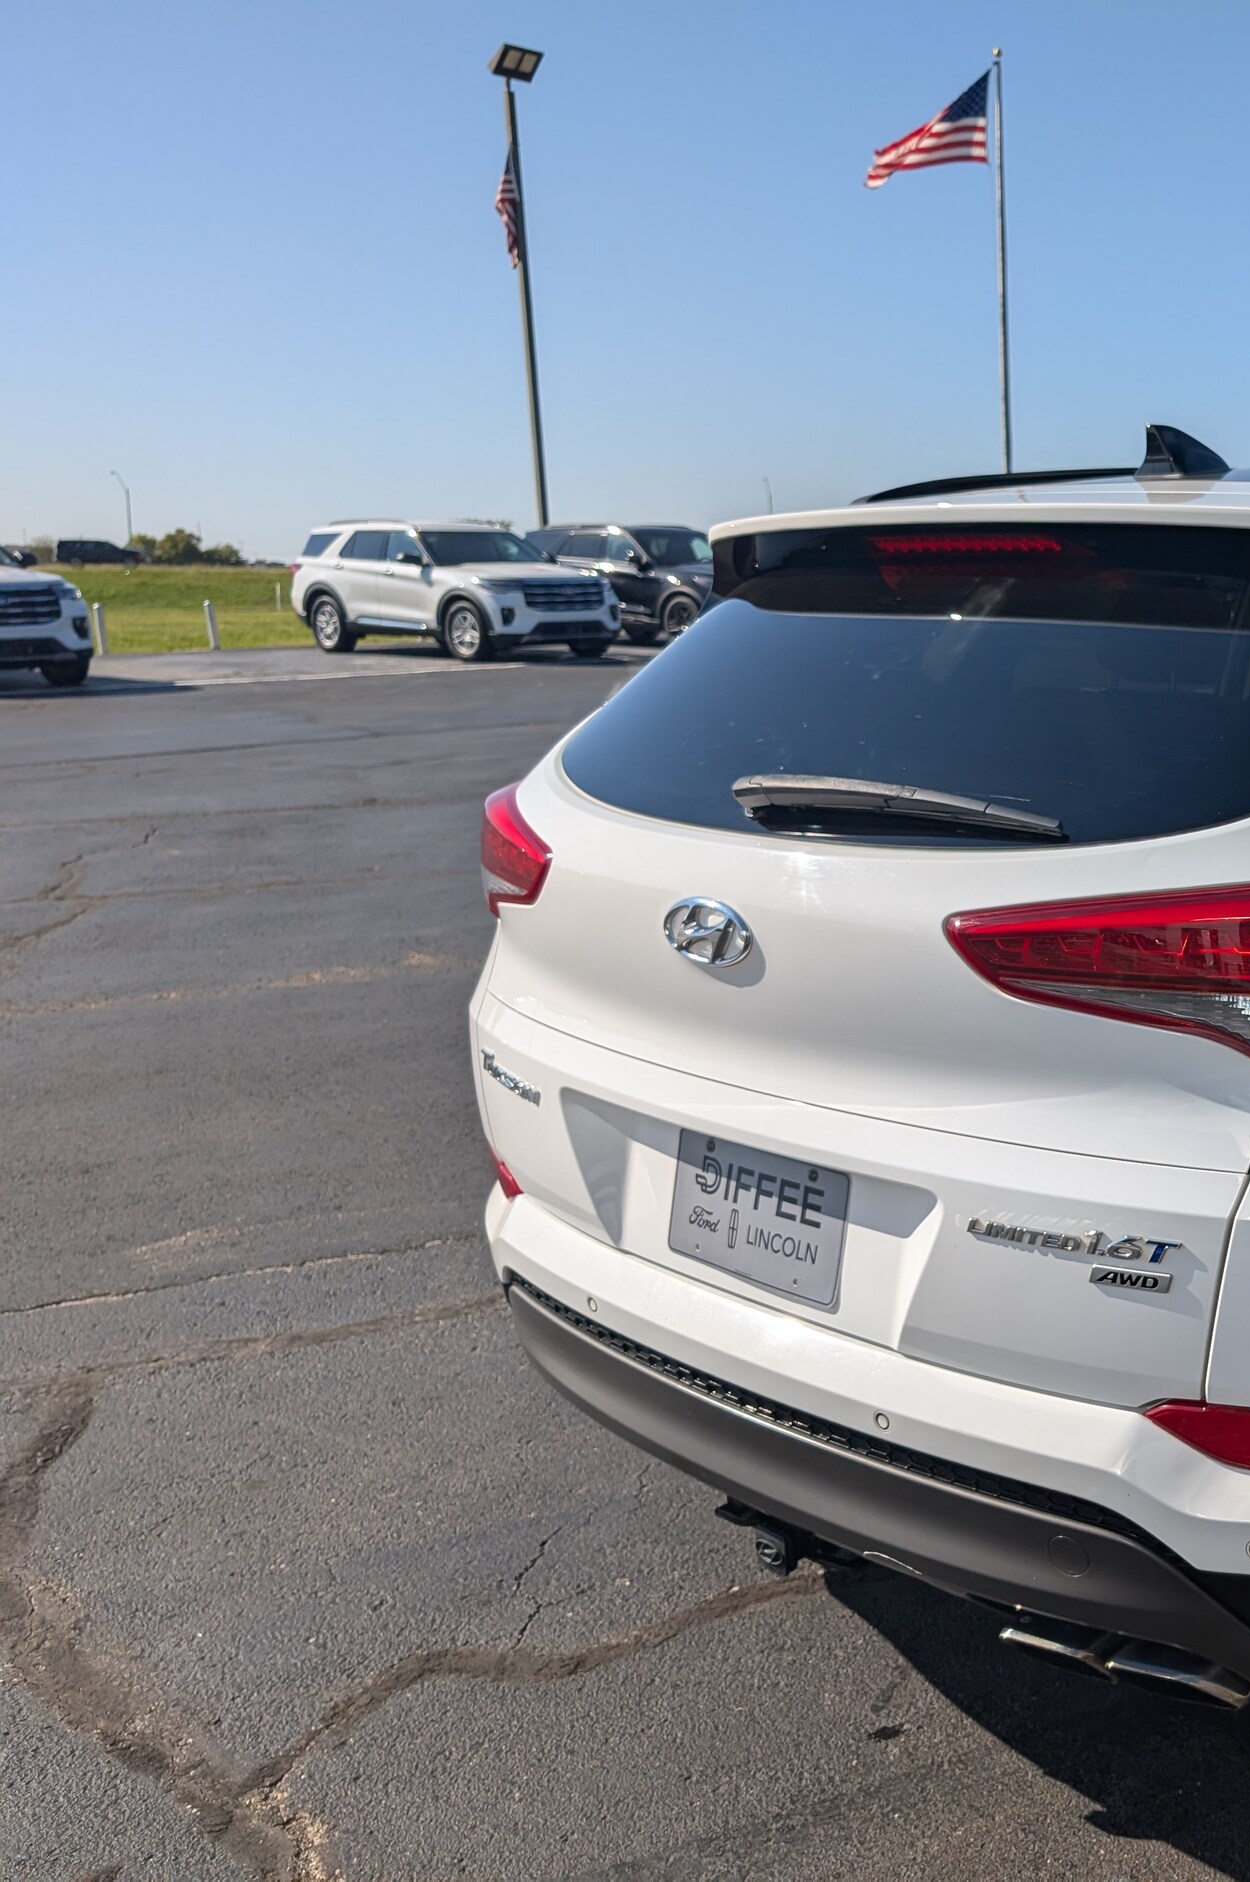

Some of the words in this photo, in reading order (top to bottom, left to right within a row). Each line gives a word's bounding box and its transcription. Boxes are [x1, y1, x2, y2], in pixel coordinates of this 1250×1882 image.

[695, 1155, 825, 1229] DIFFEE
[689, 1205, 721, 1234] Ford
[746, 1225, 818, 1265] LINCOLN
[966, 1217, 1081, 1251] LIMITED
[1085, 1229, 1182, 1264] 1.6T
[1097, 1271, 1159, 1290] AWD
